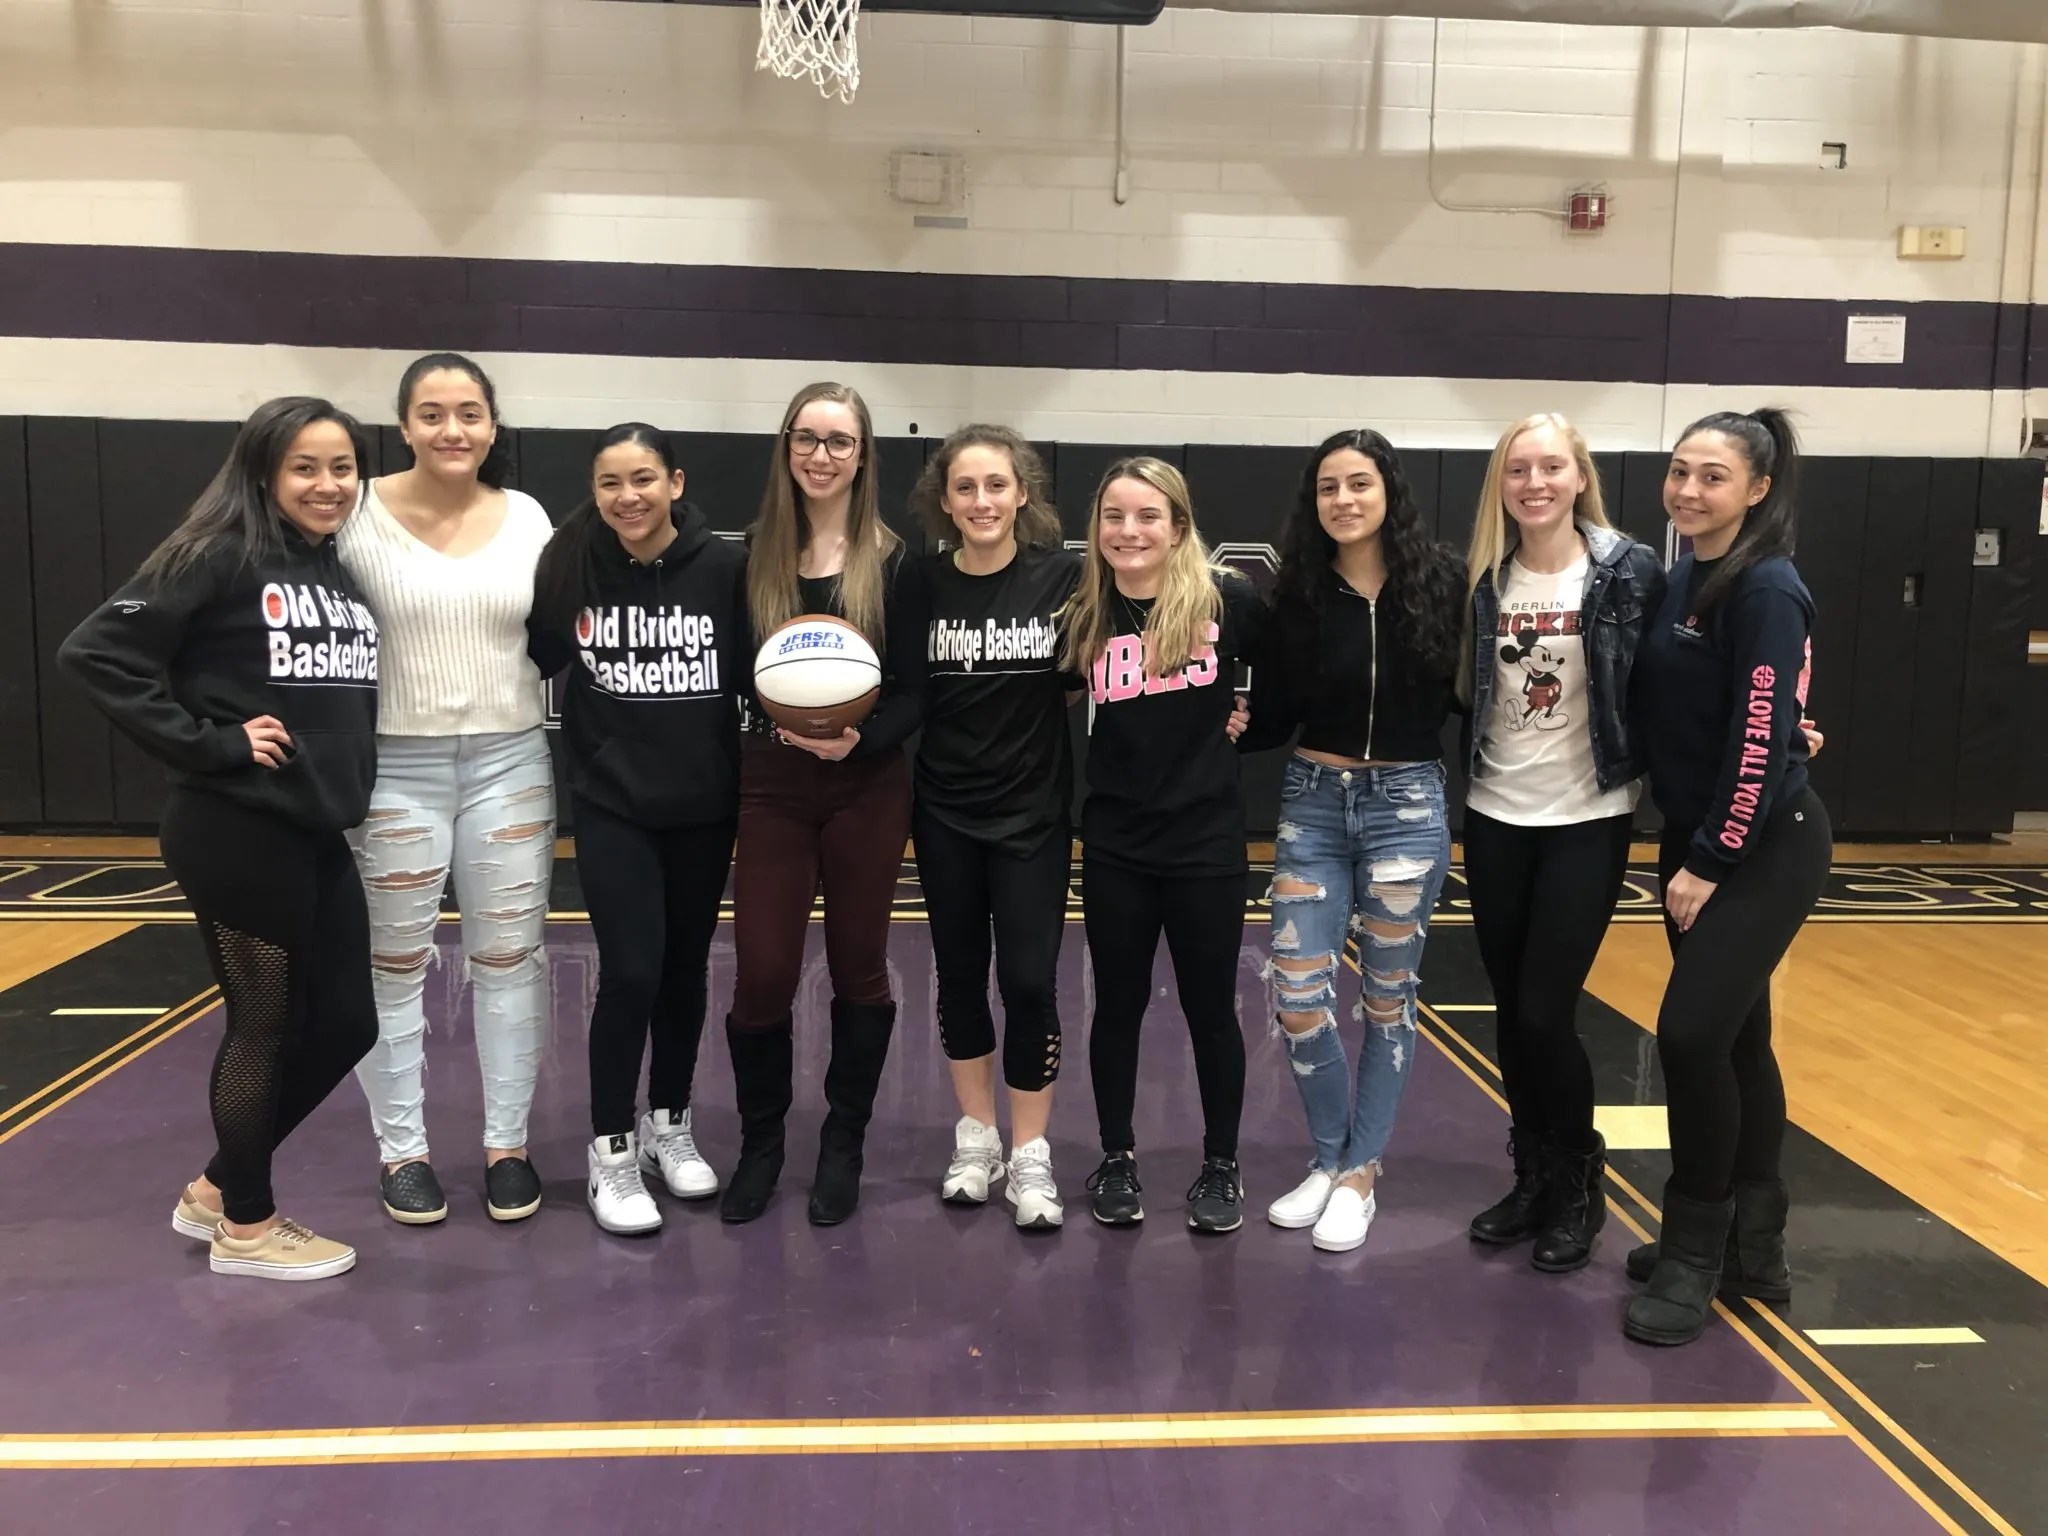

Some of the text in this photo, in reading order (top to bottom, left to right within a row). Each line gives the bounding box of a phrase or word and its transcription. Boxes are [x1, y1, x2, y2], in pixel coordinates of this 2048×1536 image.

[262, 583, 321, 628] Old
[1511, 601, 1564, 611] BERLIN
[576, 605, 714, 658] Old Bridge
[936, 619, 982, 672] Bridge
[985, 617, 1057, 661] Basketball
[580, 649, 720, 694] Basketball
[1719, 689, 1774, 849] LOVE ALL YOU DO
